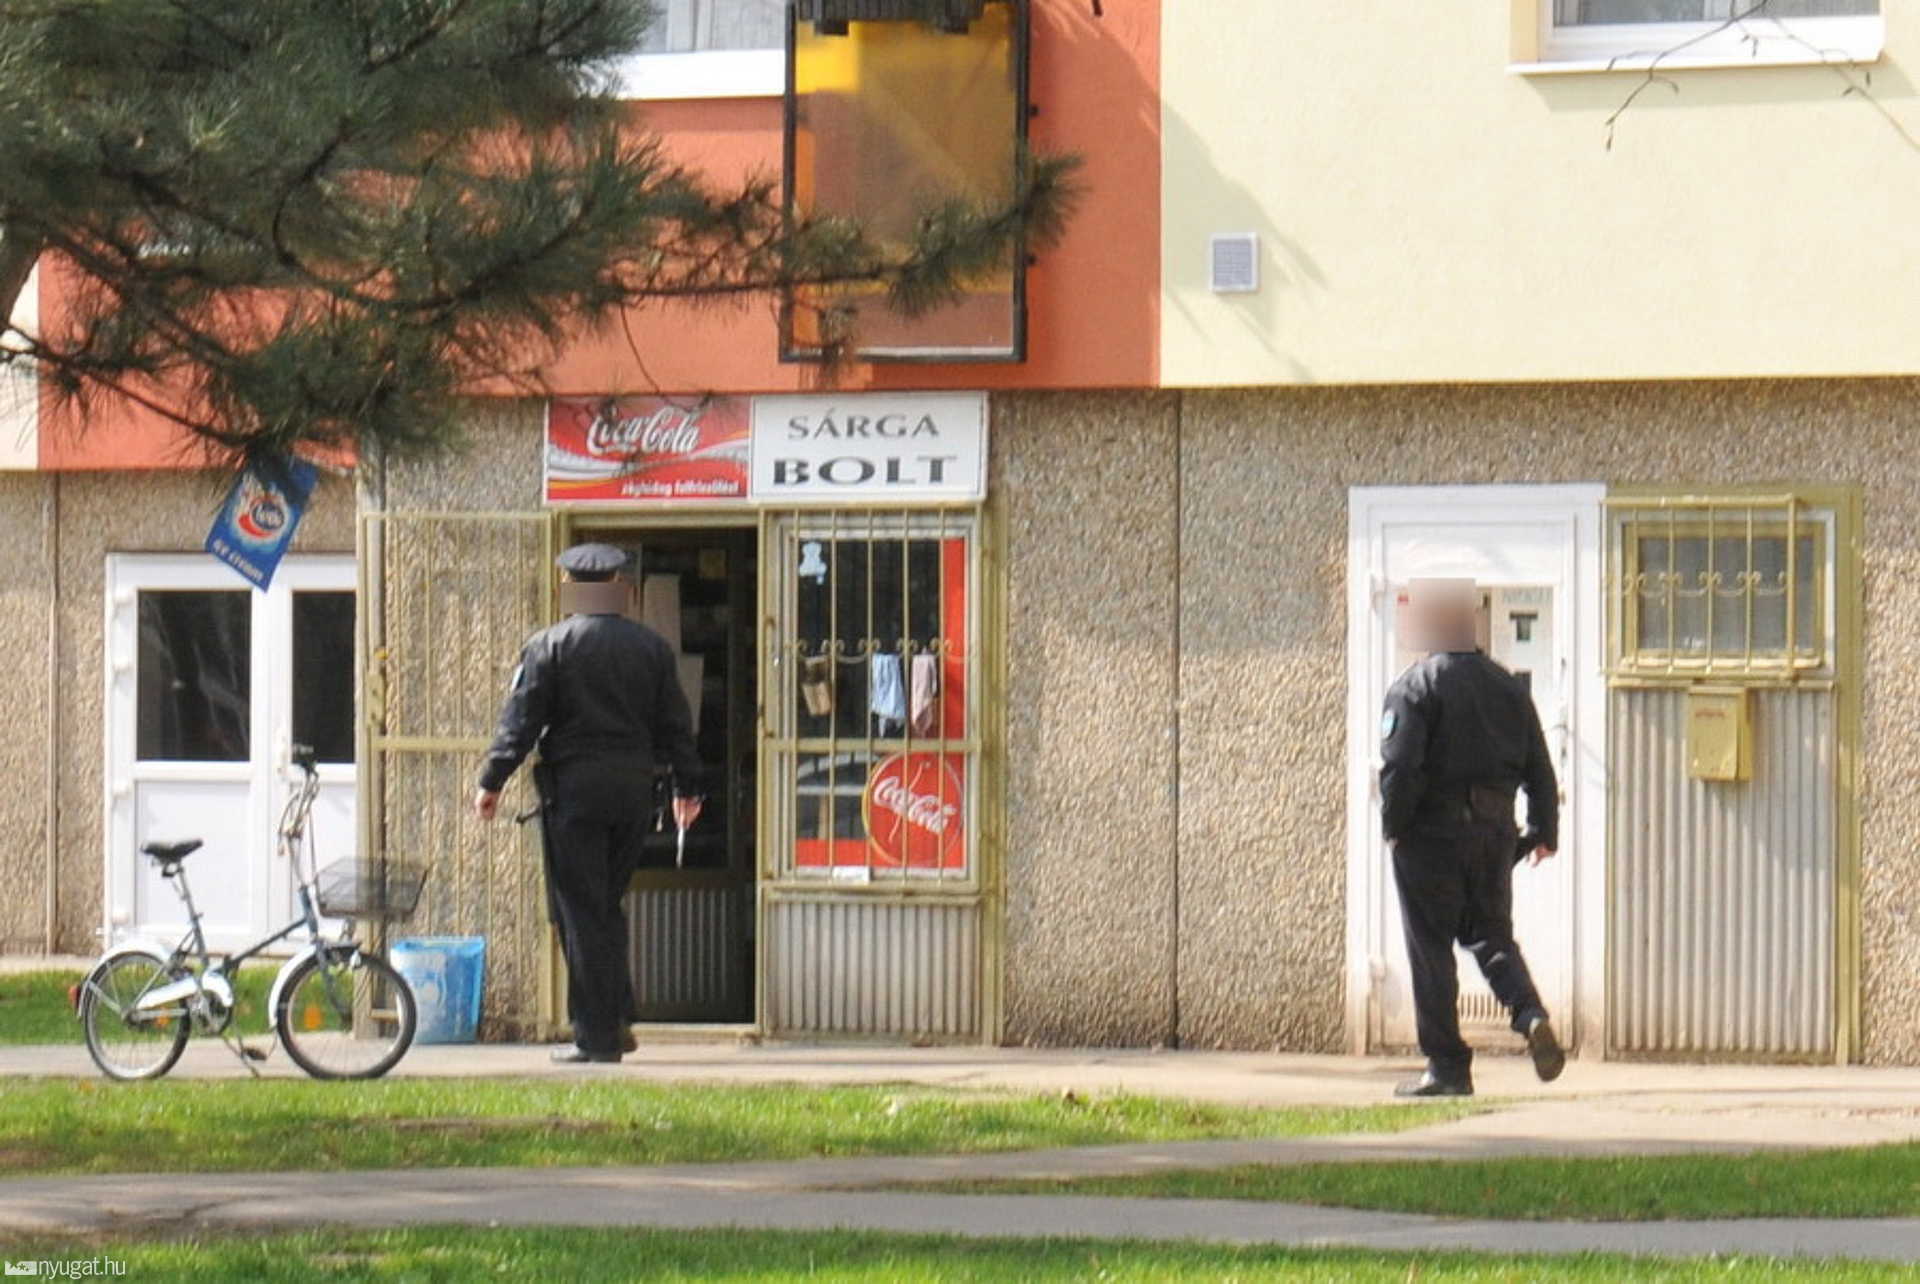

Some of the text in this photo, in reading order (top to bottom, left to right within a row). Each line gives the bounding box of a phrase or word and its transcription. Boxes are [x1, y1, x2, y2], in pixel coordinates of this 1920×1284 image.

[788, 407, 940, 439] SÁRGA
[774, 456, 957, 486] BOLT
[874, 775, 957, 835] Coca-Cola
